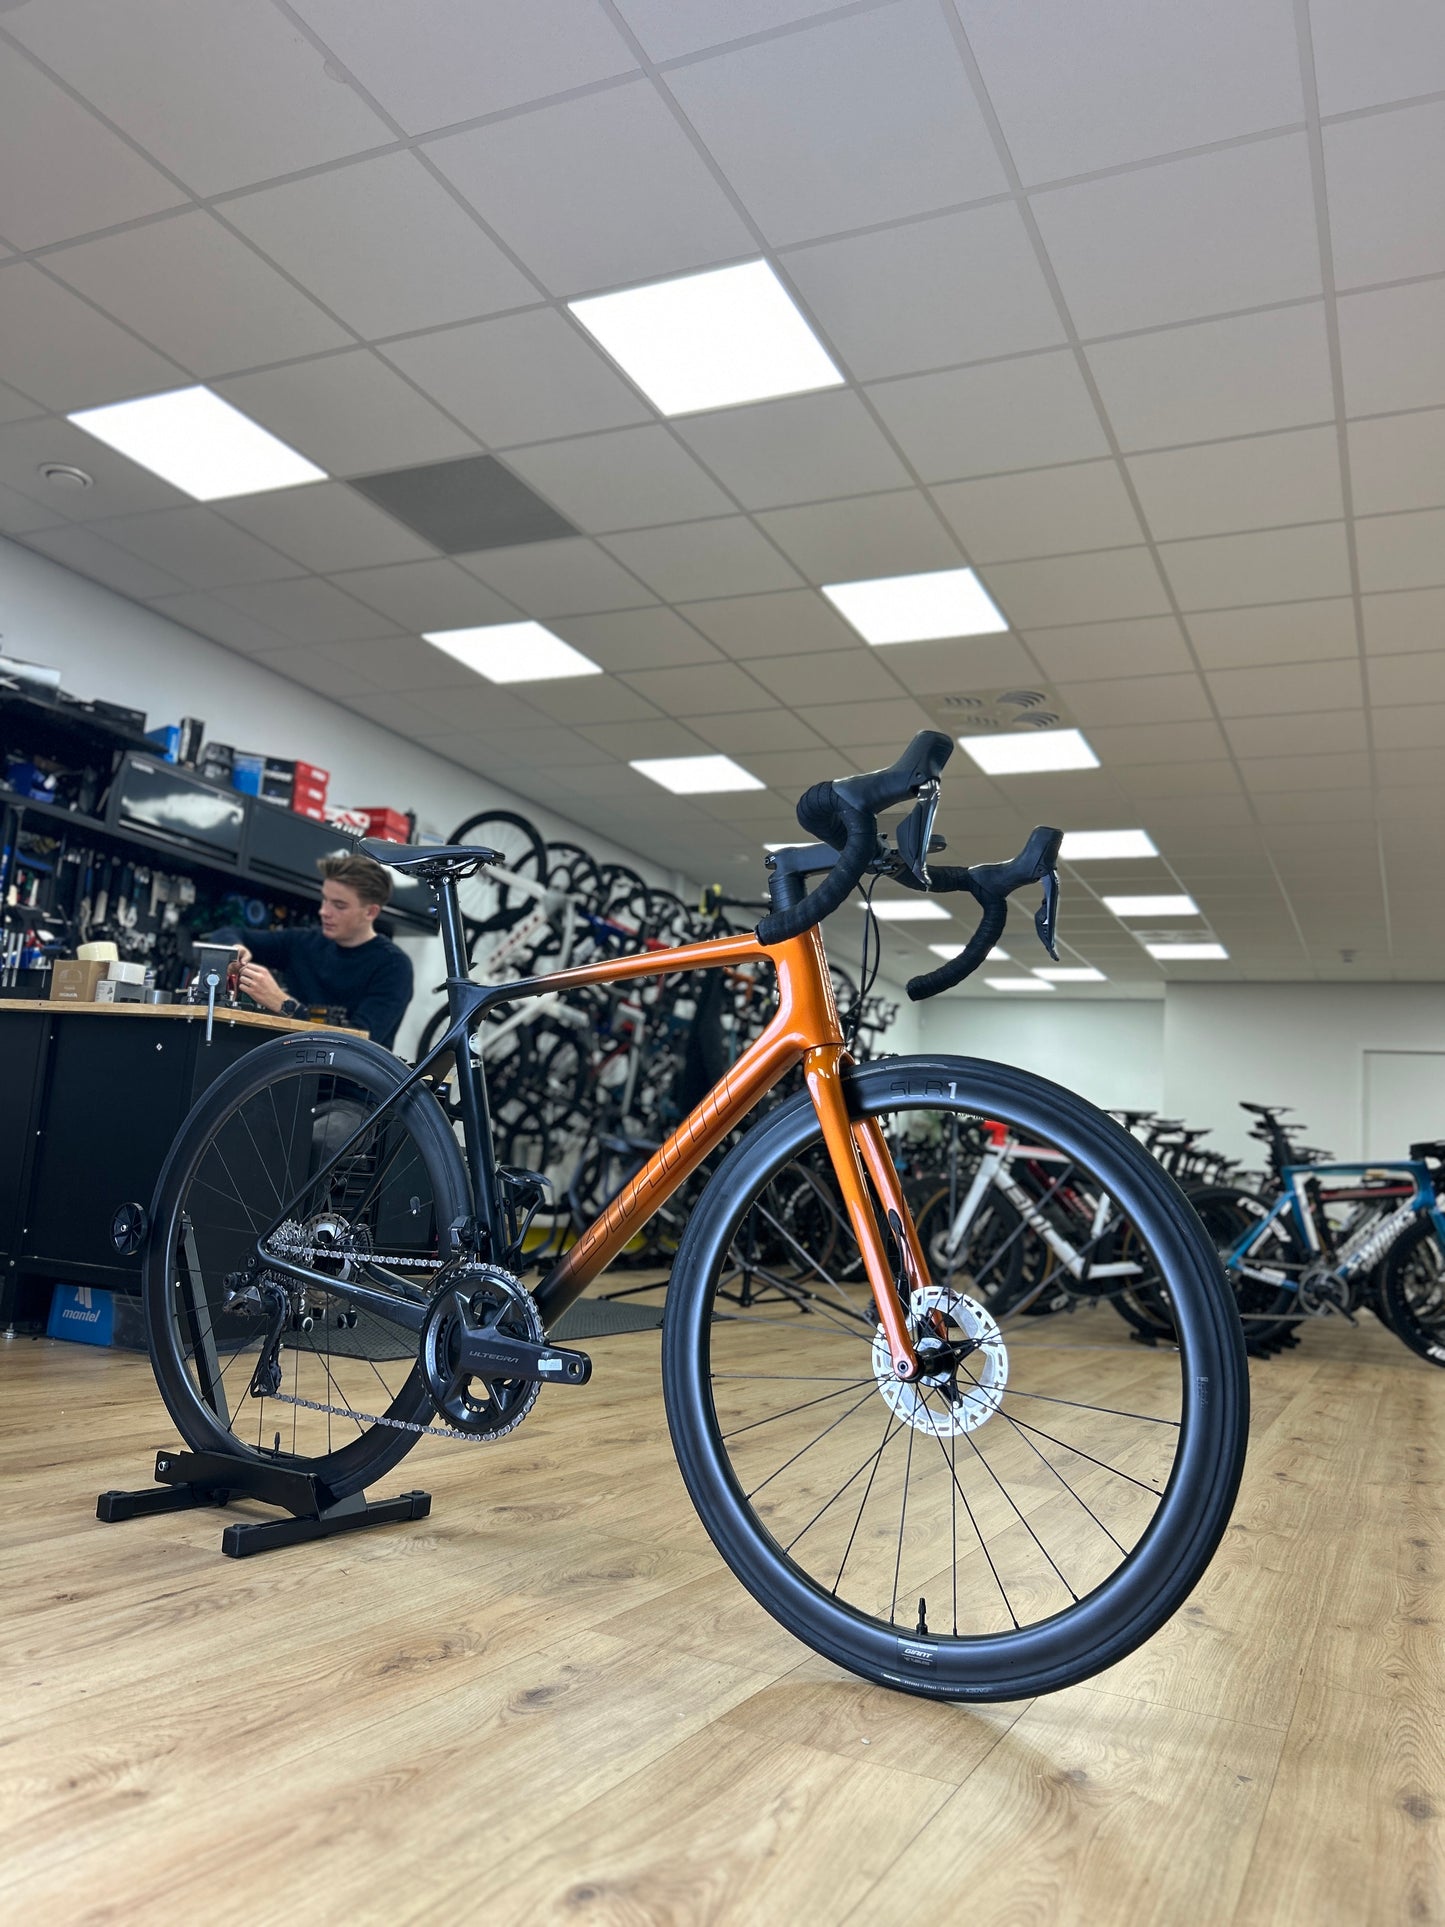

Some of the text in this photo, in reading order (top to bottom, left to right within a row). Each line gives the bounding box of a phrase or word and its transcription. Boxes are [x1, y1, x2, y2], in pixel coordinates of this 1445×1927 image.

[62, 1308, 101, 1322] mantel
[468, 1350, 519, 1364] ULTEGRA
[904, 1648, 933, 1658] GIANT
